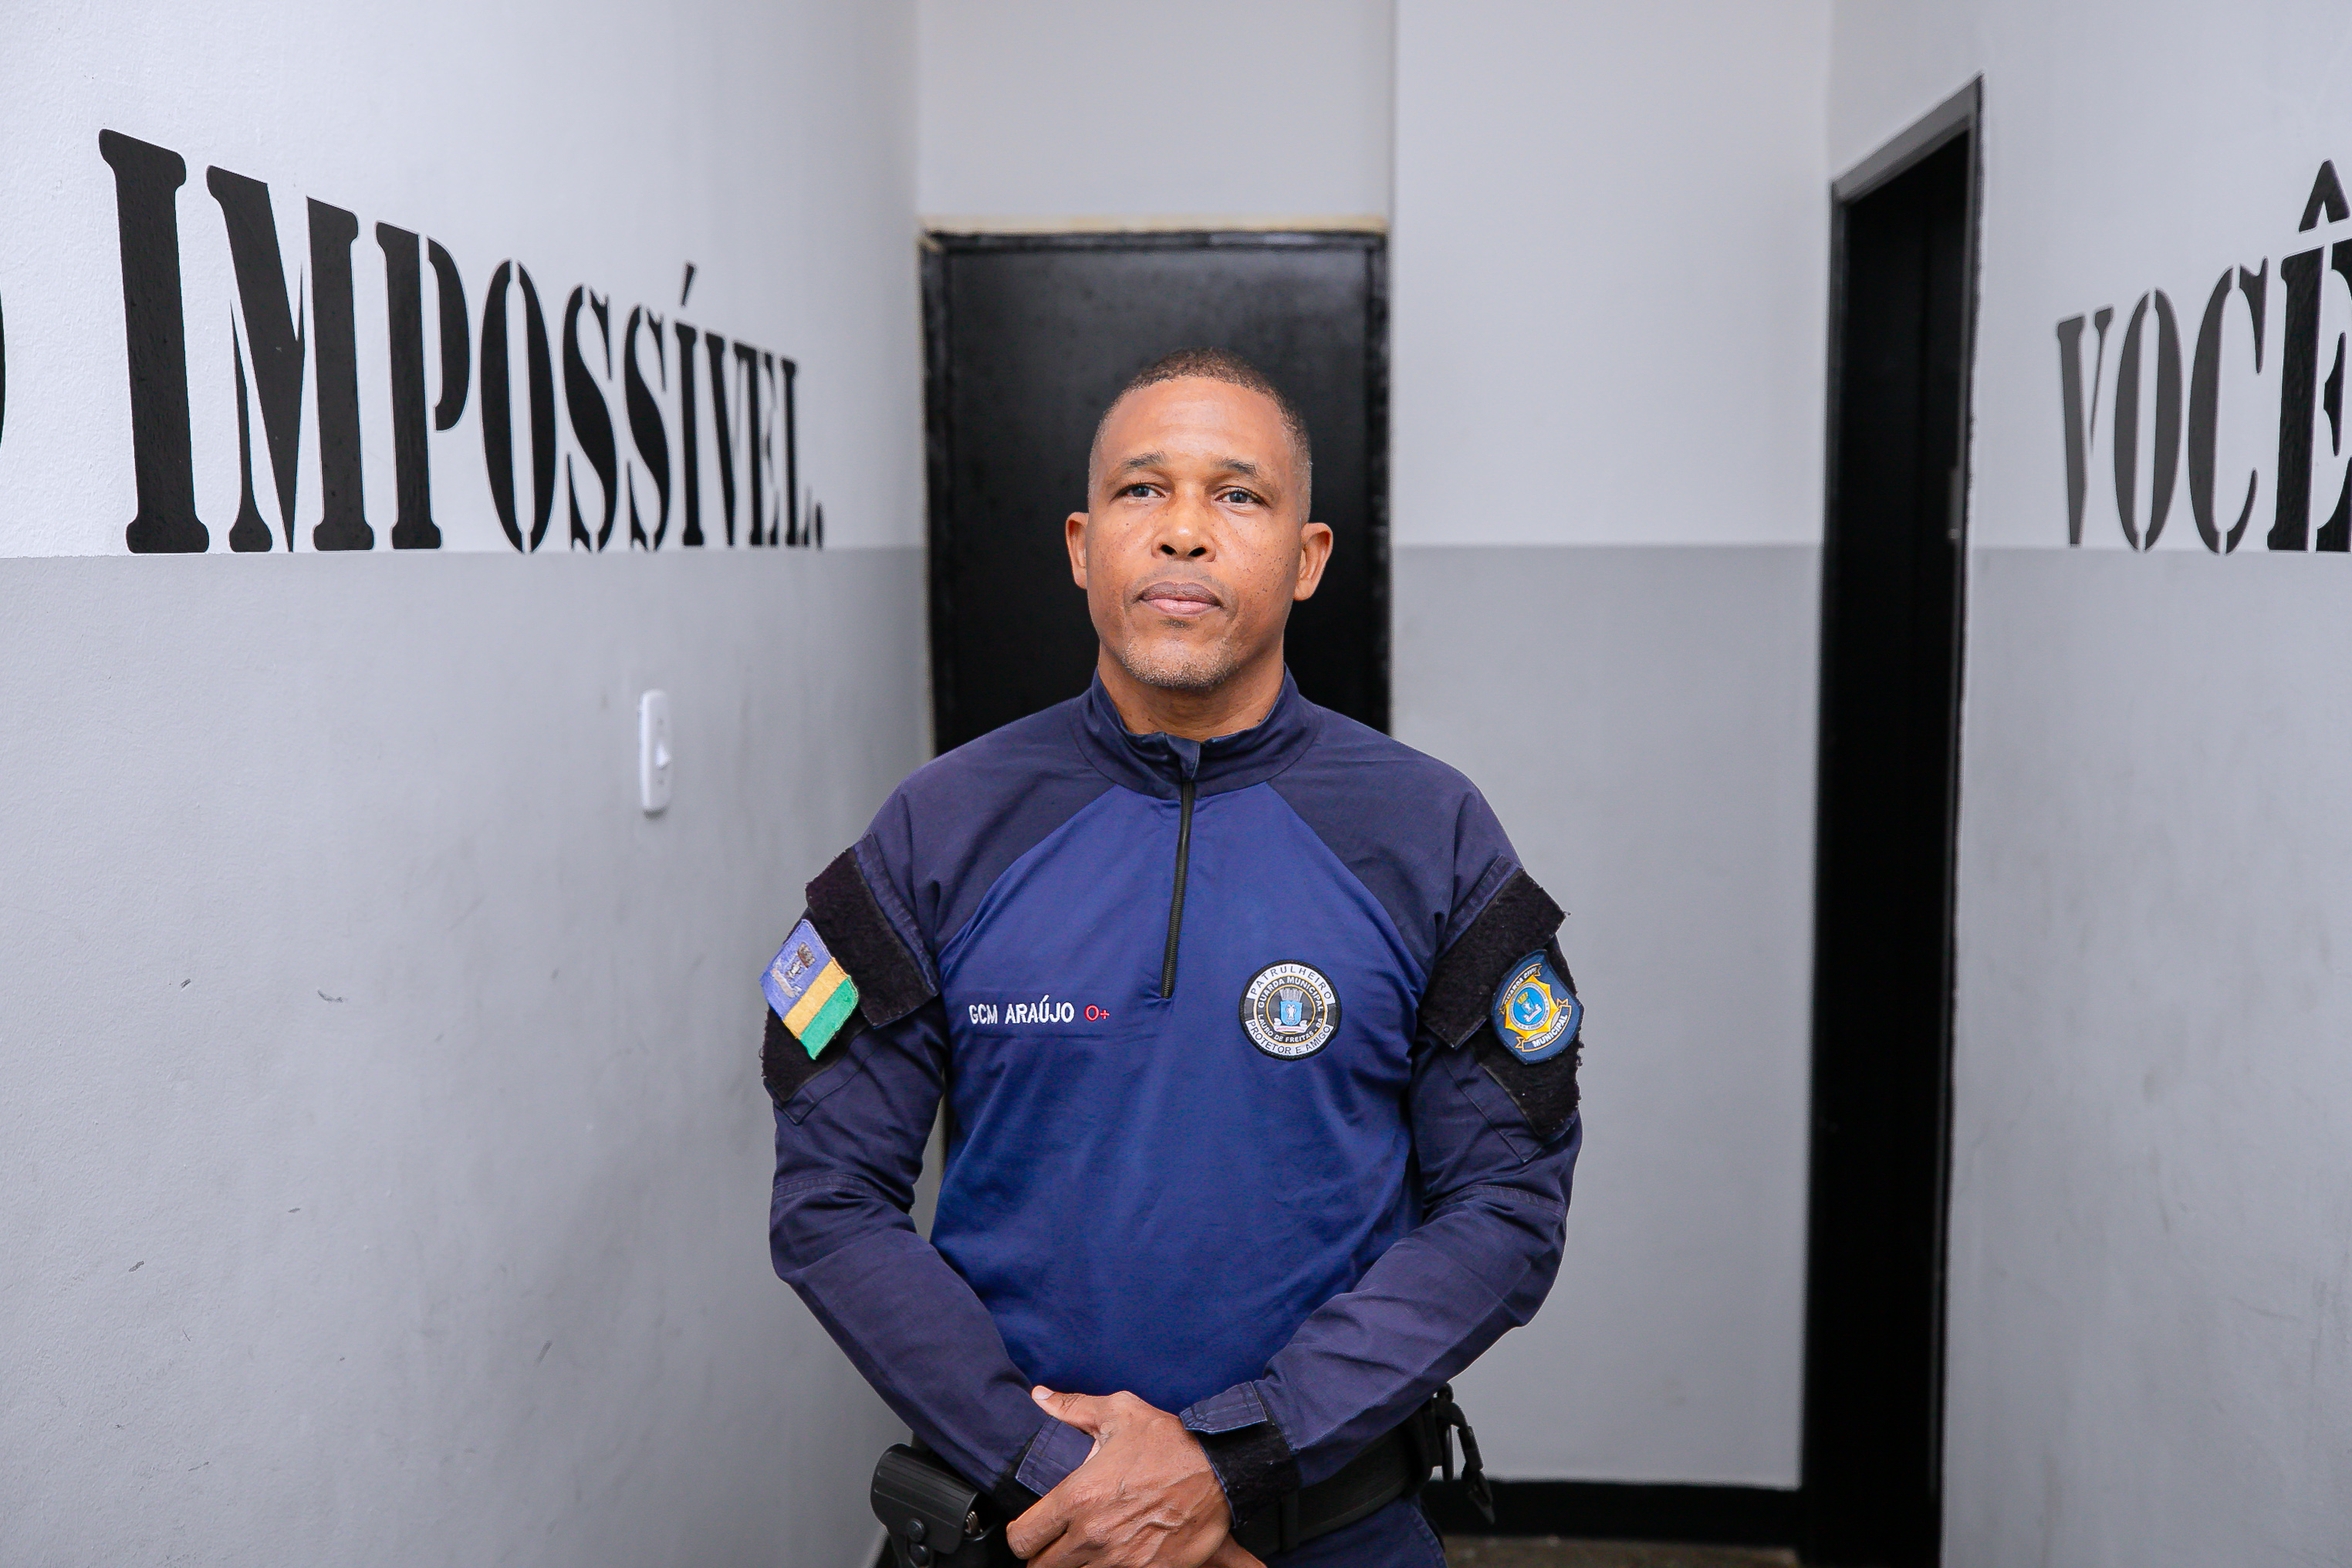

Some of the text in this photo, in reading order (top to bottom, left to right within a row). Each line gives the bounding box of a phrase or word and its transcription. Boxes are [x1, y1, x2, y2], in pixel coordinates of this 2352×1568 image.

[99, 128, 823, 553] IMPOSSÍVEL.
[2057, 159, 2352, 554] VOCÊ
[1251, 966, 1331, 999] PATRULHEIRO
[1258, 976, 1324, 1012] GUARDA MUNICIPAL
[968, 1003, 998, 1025] GCM
[1005, 995, 1075, 1025] ARAÚJO
[1248, 1020, 1292, 1055] PROTETOR
[1306, 1026, 1330, 1052] AMIGO
[1258, 1014, 1274, 1037] LAURO
[1285, 1030, 1315, 1043] FREITAS
[1315, 1018, 1323, 1029] BA
[1532, 1014, 1568, 1048] MUNICIPAL
